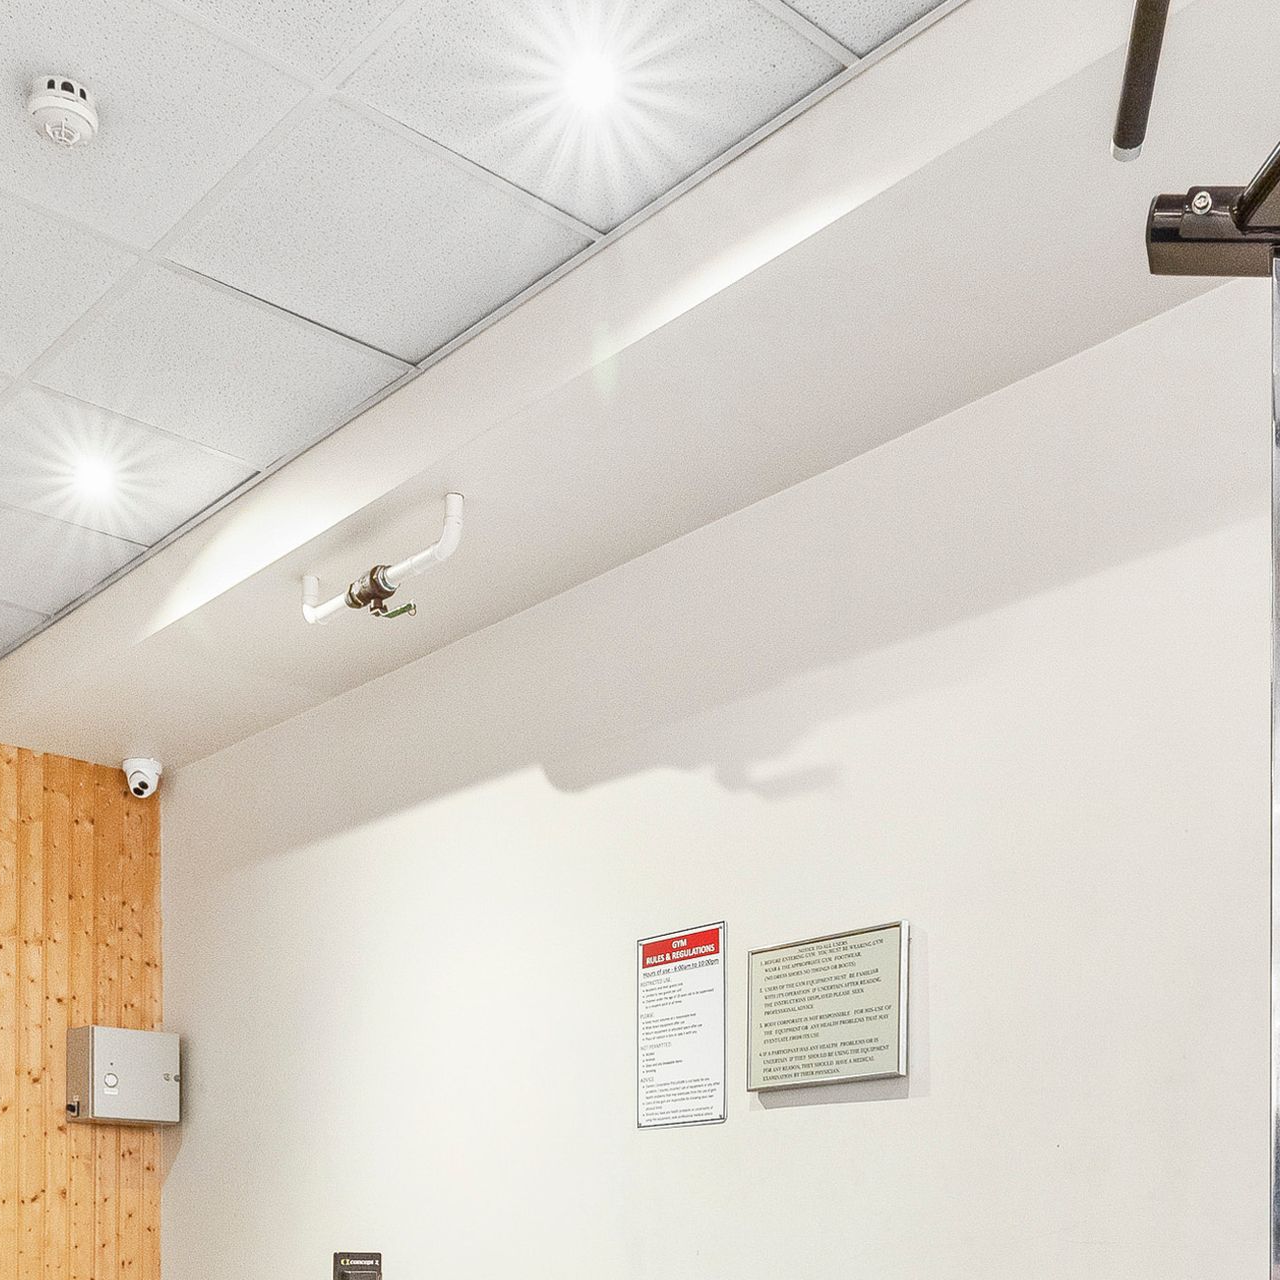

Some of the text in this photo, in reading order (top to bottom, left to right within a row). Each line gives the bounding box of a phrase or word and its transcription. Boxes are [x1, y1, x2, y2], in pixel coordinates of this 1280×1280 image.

[672, 939, 687, 948] GYM
[646, 954, 664, 965] RULES
[672, 944, 715, 959] REGULATIONS
